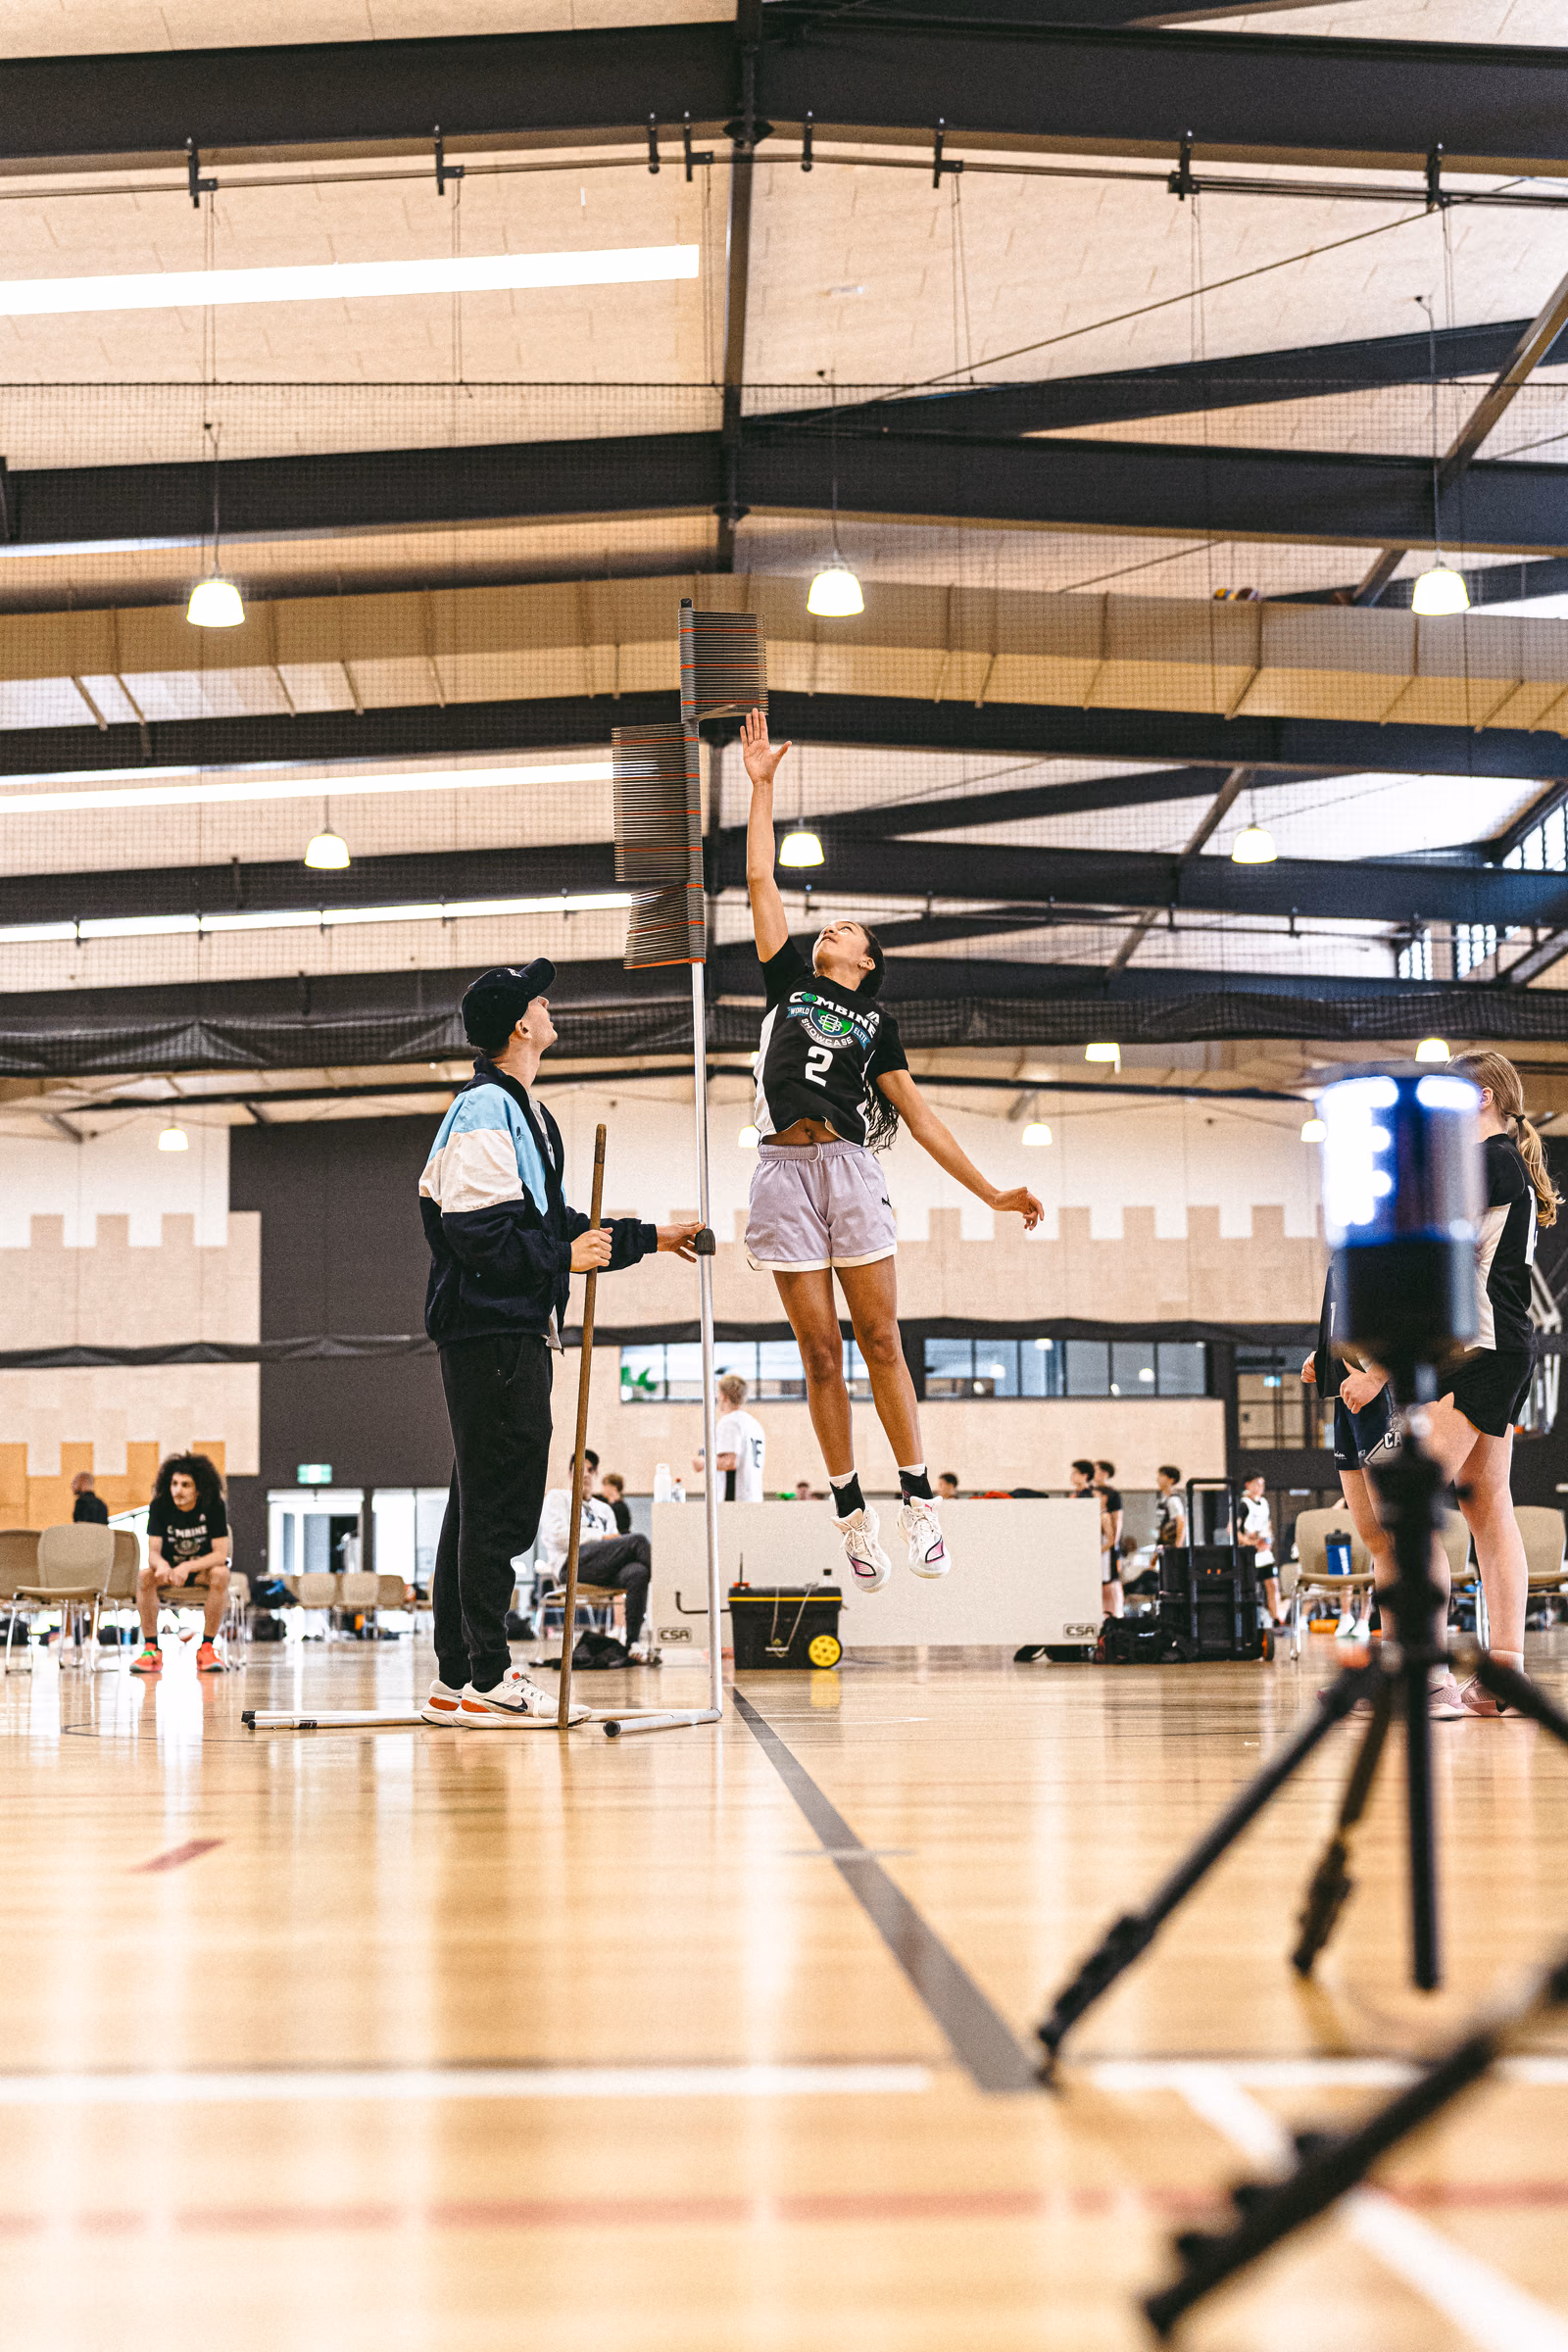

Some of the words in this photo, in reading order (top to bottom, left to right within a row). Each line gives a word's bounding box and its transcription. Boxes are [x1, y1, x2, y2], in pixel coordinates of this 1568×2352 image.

[790, 1006, 810, 1015] WORLD
[801, 1017, 854, 1047] SHOWCASE
[853, 1027, 868, 1044] ELITE
[805, 1045, 834, 1088] 2
[1525, 1185, 1539, 1266] 1
